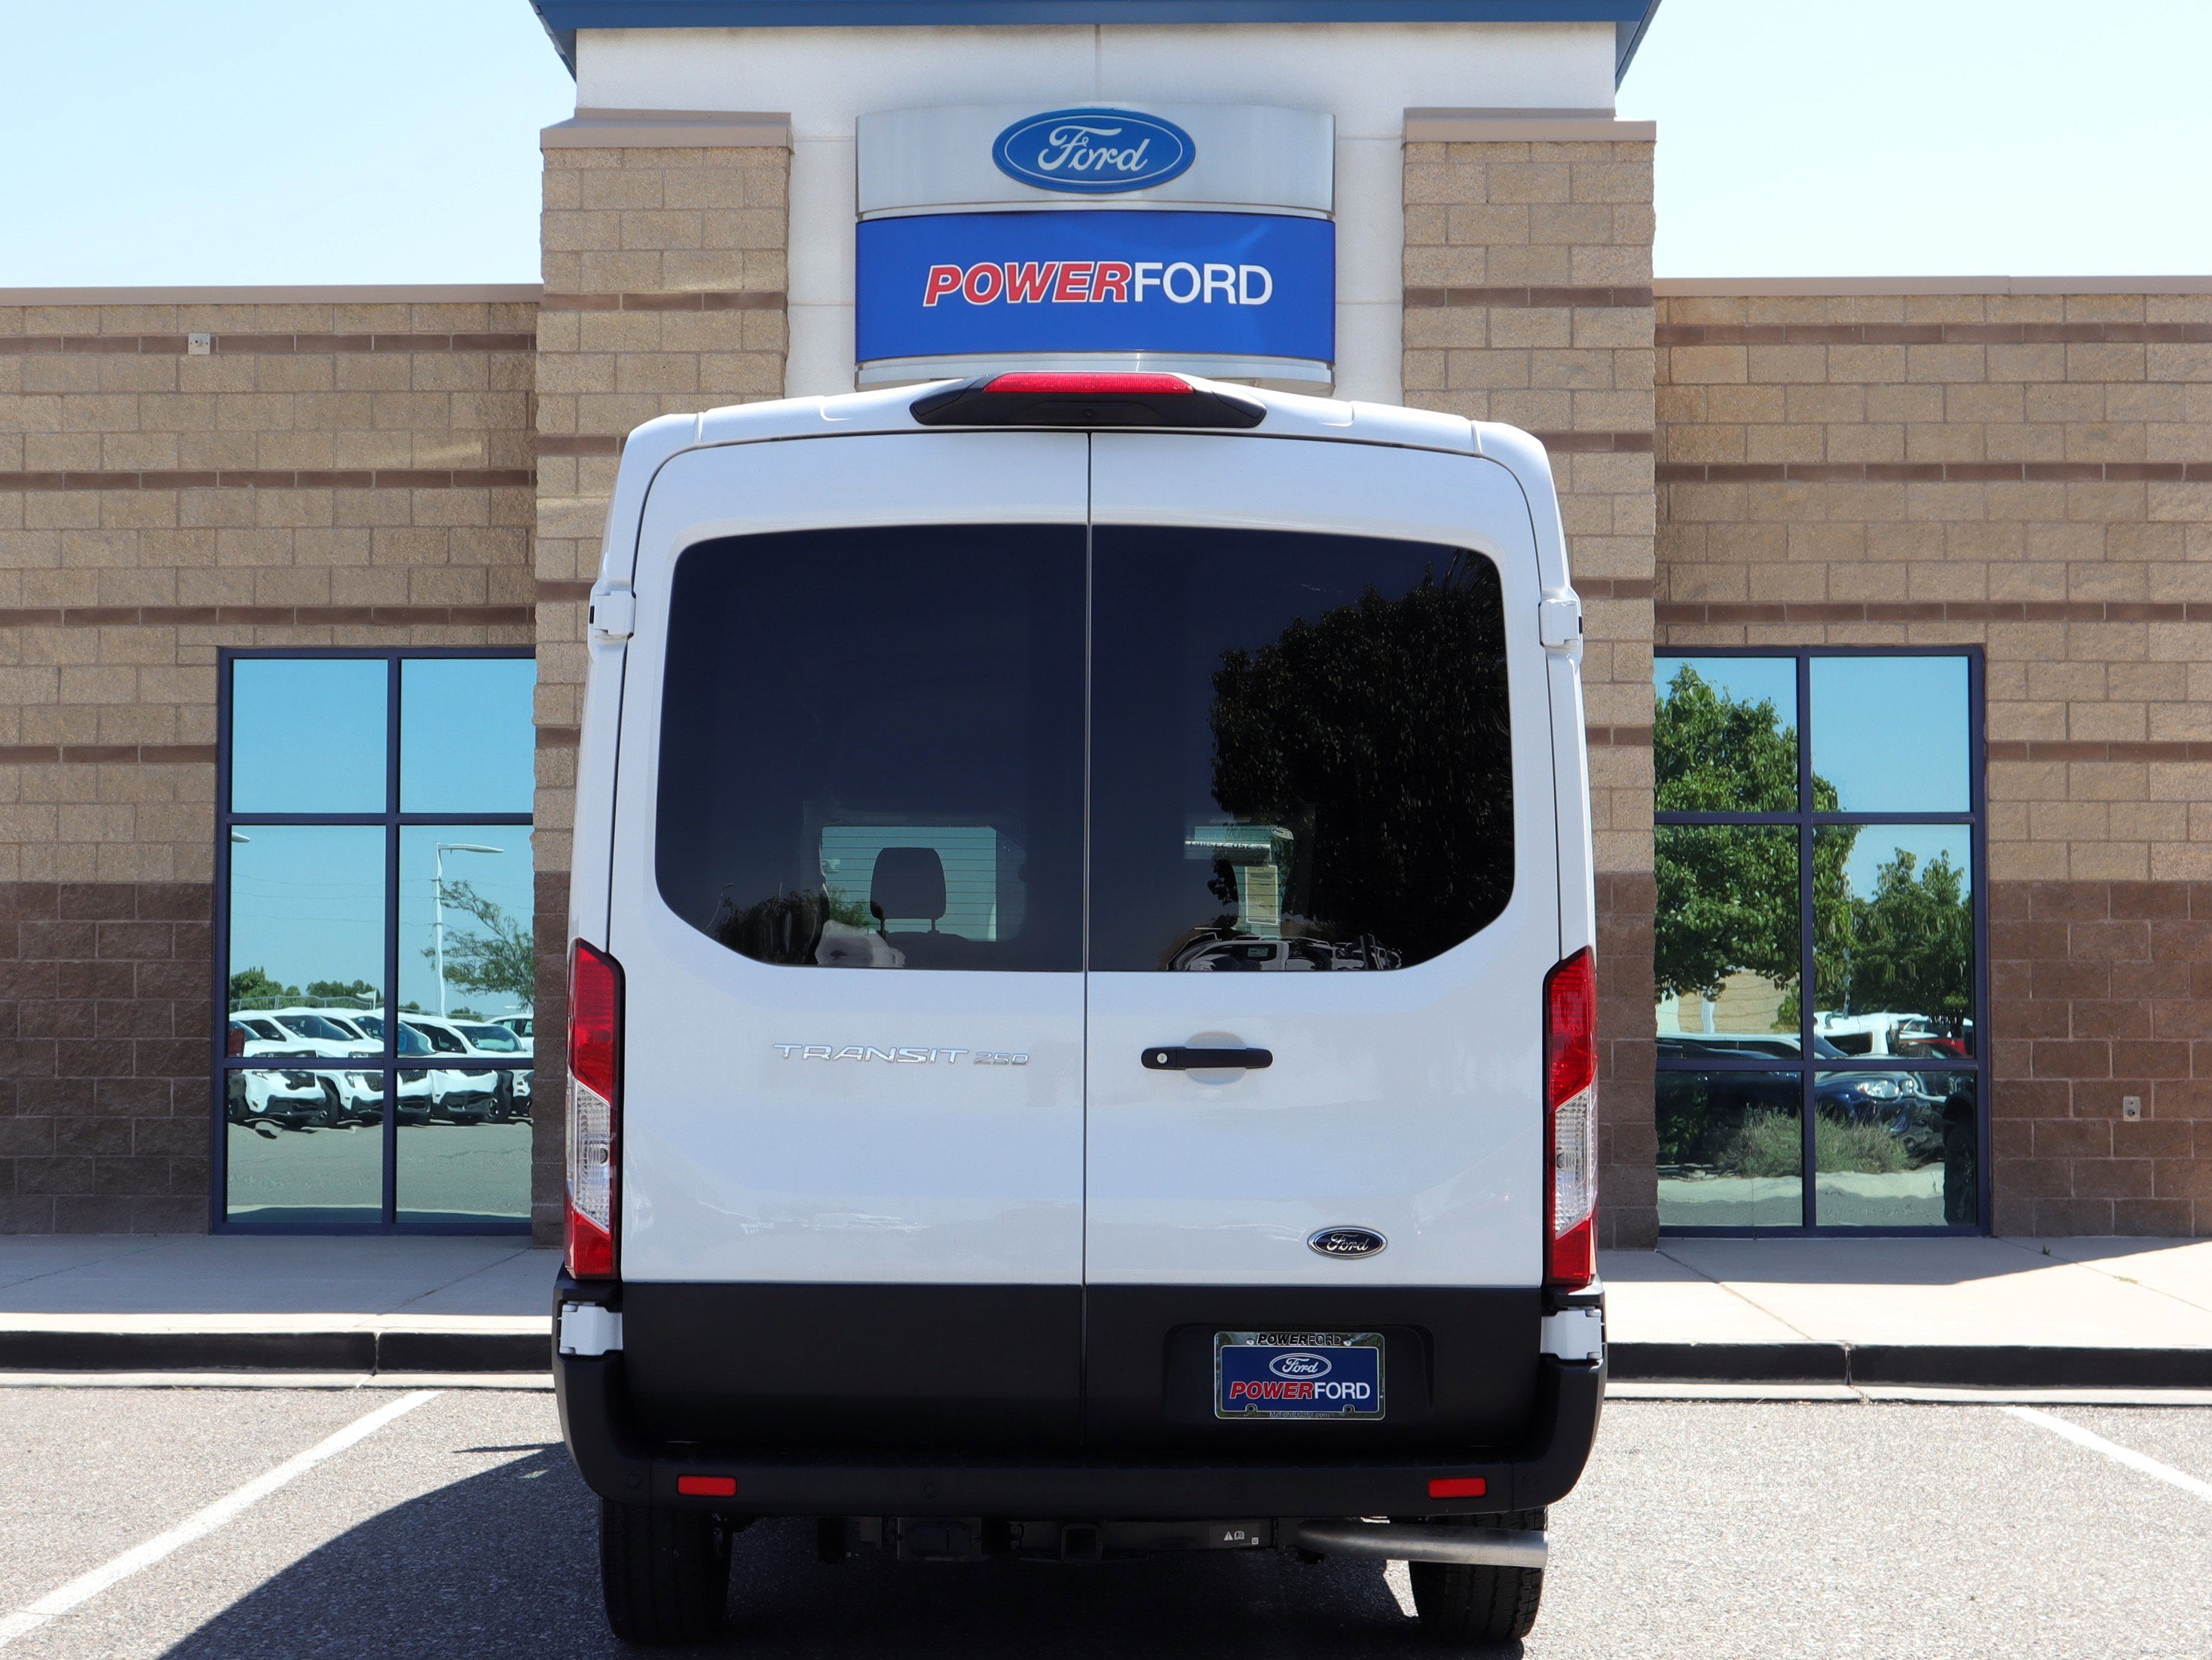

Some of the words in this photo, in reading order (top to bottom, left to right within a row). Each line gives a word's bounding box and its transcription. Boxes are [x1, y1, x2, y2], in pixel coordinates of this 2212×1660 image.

[1037, 124, 1150, 172] Ford
[922, 261, 1273, 307] POWERFORD
[773, 1043, 969, 1064] TRANSIT
[973, 1051, 1030, 1066] 250
[1326, 1233, 1370, 1251] Ford
[1256, 1334, 1343, 1346] POWERFORD
[1281, 1356, 1319, 1374] Ford
[1229, 1380, 1371, 1400] POWERFORD
